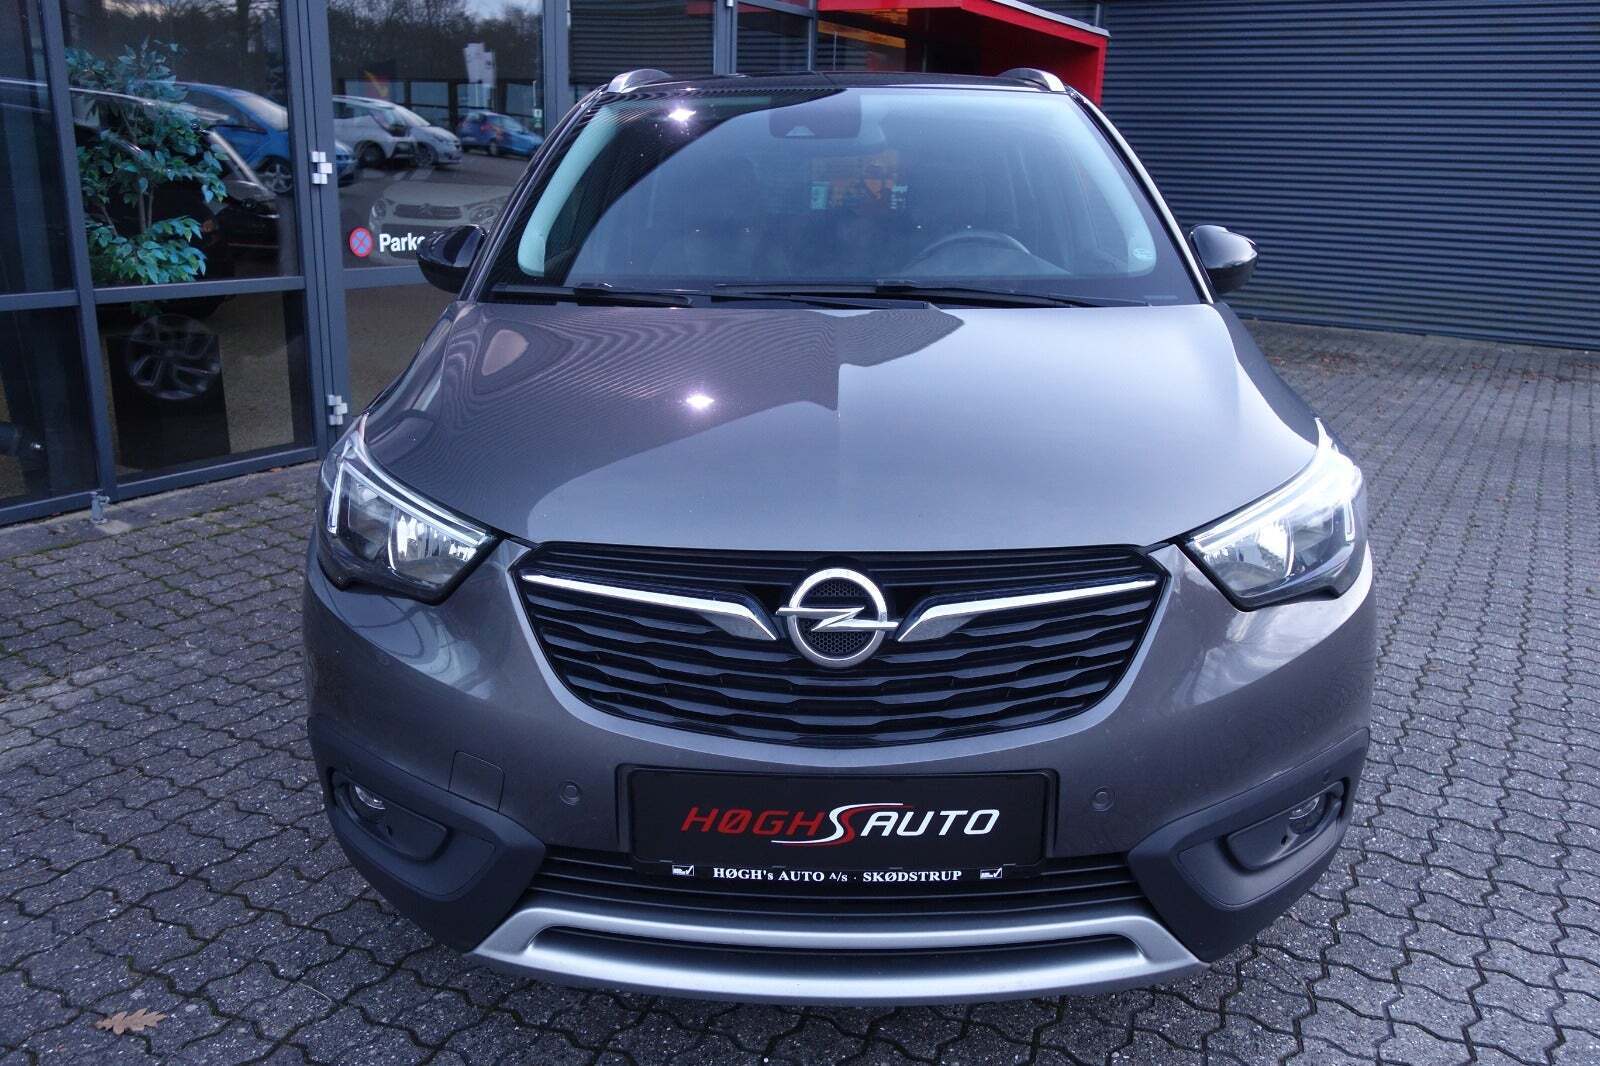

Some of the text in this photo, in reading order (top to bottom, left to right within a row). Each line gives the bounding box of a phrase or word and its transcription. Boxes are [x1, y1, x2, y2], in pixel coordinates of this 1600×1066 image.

[860, 809, 1000, 837] AUTO
[778, 871, 825, 882] AUTO
[862, 870, 962, 882] SKØDSTRUP
